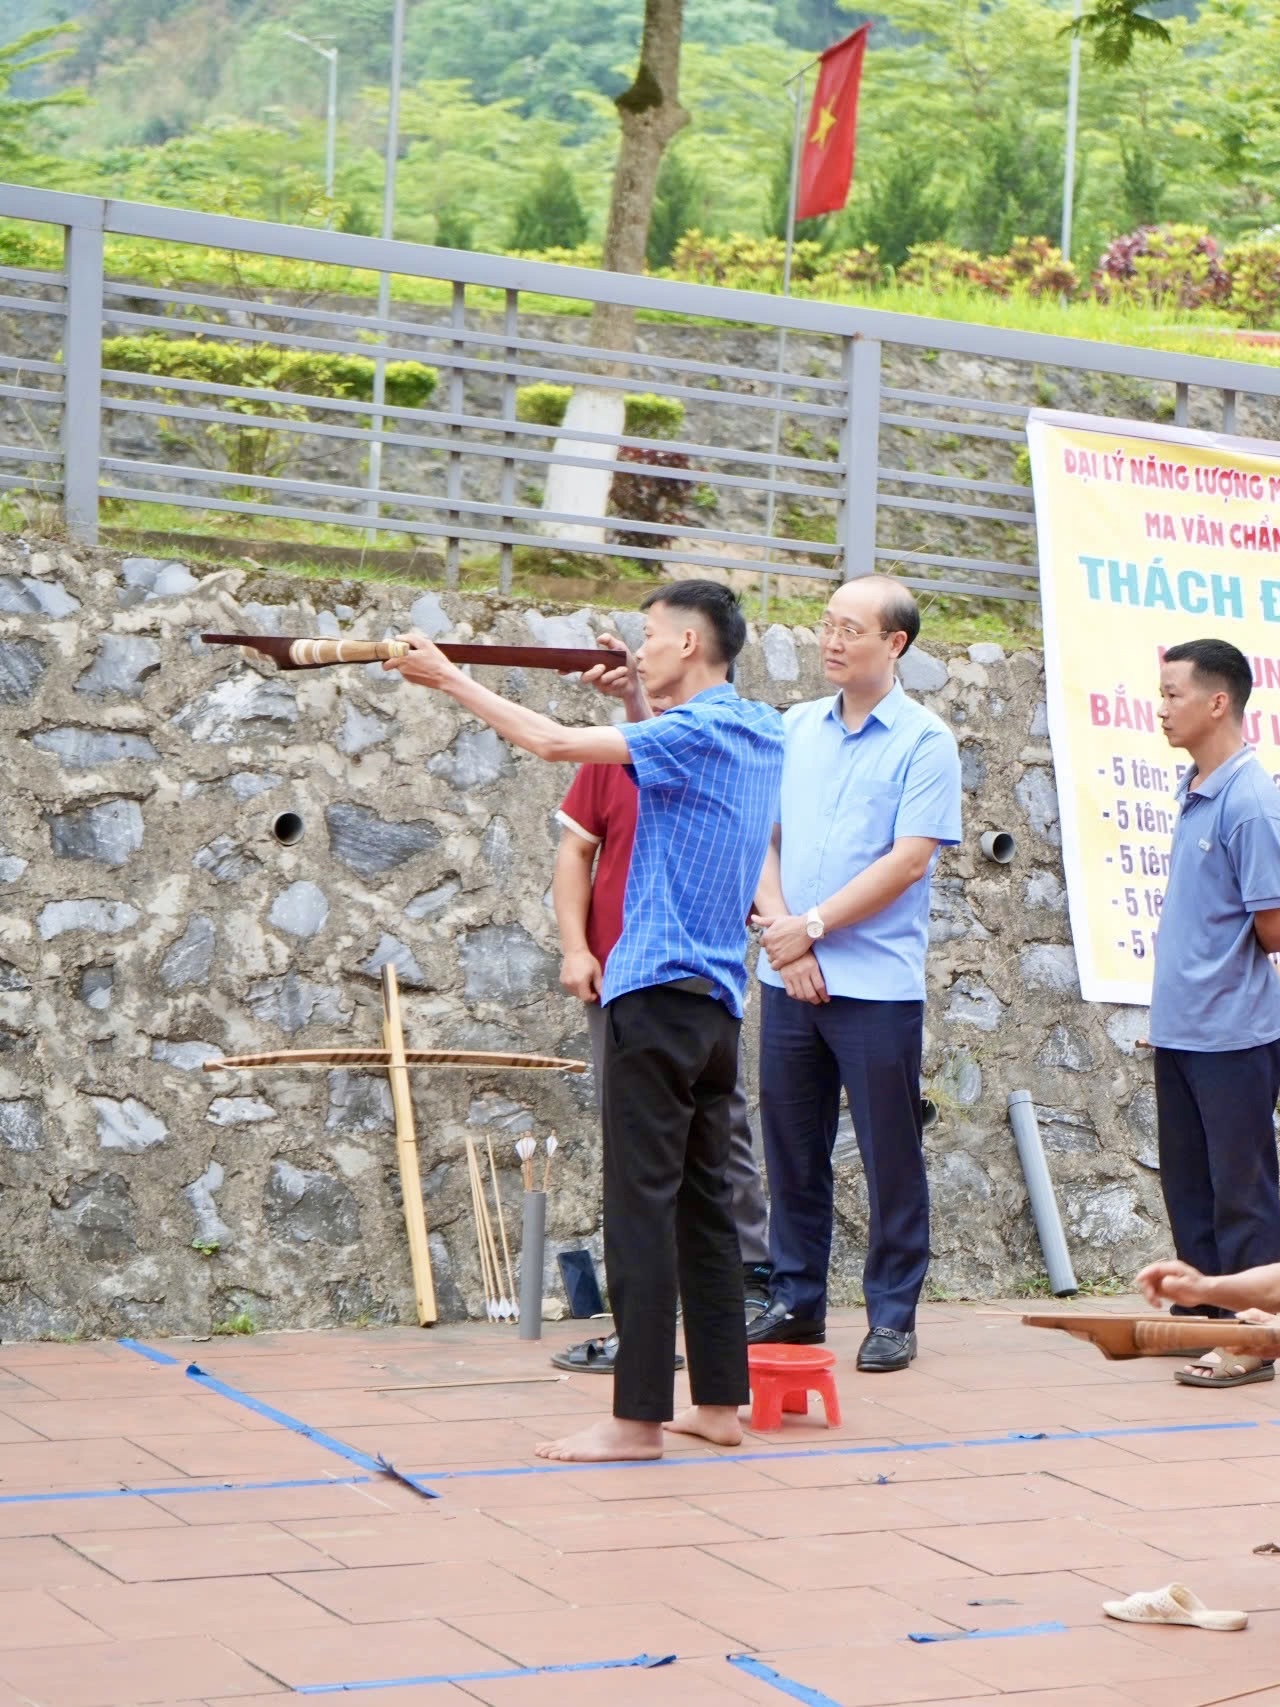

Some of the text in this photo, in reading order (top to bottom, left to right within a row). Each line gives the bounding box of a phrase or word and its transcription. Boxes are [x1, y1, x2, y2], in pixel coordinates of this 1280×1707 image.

[1064, 448, 1098, 483] ĐẠI
[1103, 449, 1124, 482] LÝ
[1130, 455, 1190, 491] NĂNG
[1195, 467, 1264, 503] LƯỢNG
[1145, 512, 1177, 541] MA
[1181, 514, 1225, 546] VĂN
[1078, 555, 1244, 619] THÁCH
[1089, 684, 1155, 733] BẮN
[1112, 756, 1126, 786] 5
[1131, 759, 1170, 793] tên:
[1116, 800, 1130, 830] 5
[1135, 801, 1175, 834] tên:
[1119, 844, 1134, 874] 5
[1139, 845, 1171, 877] tên
[1124, 887, 1139, 917] 5
[1130, 930, 1146, 960] 5
